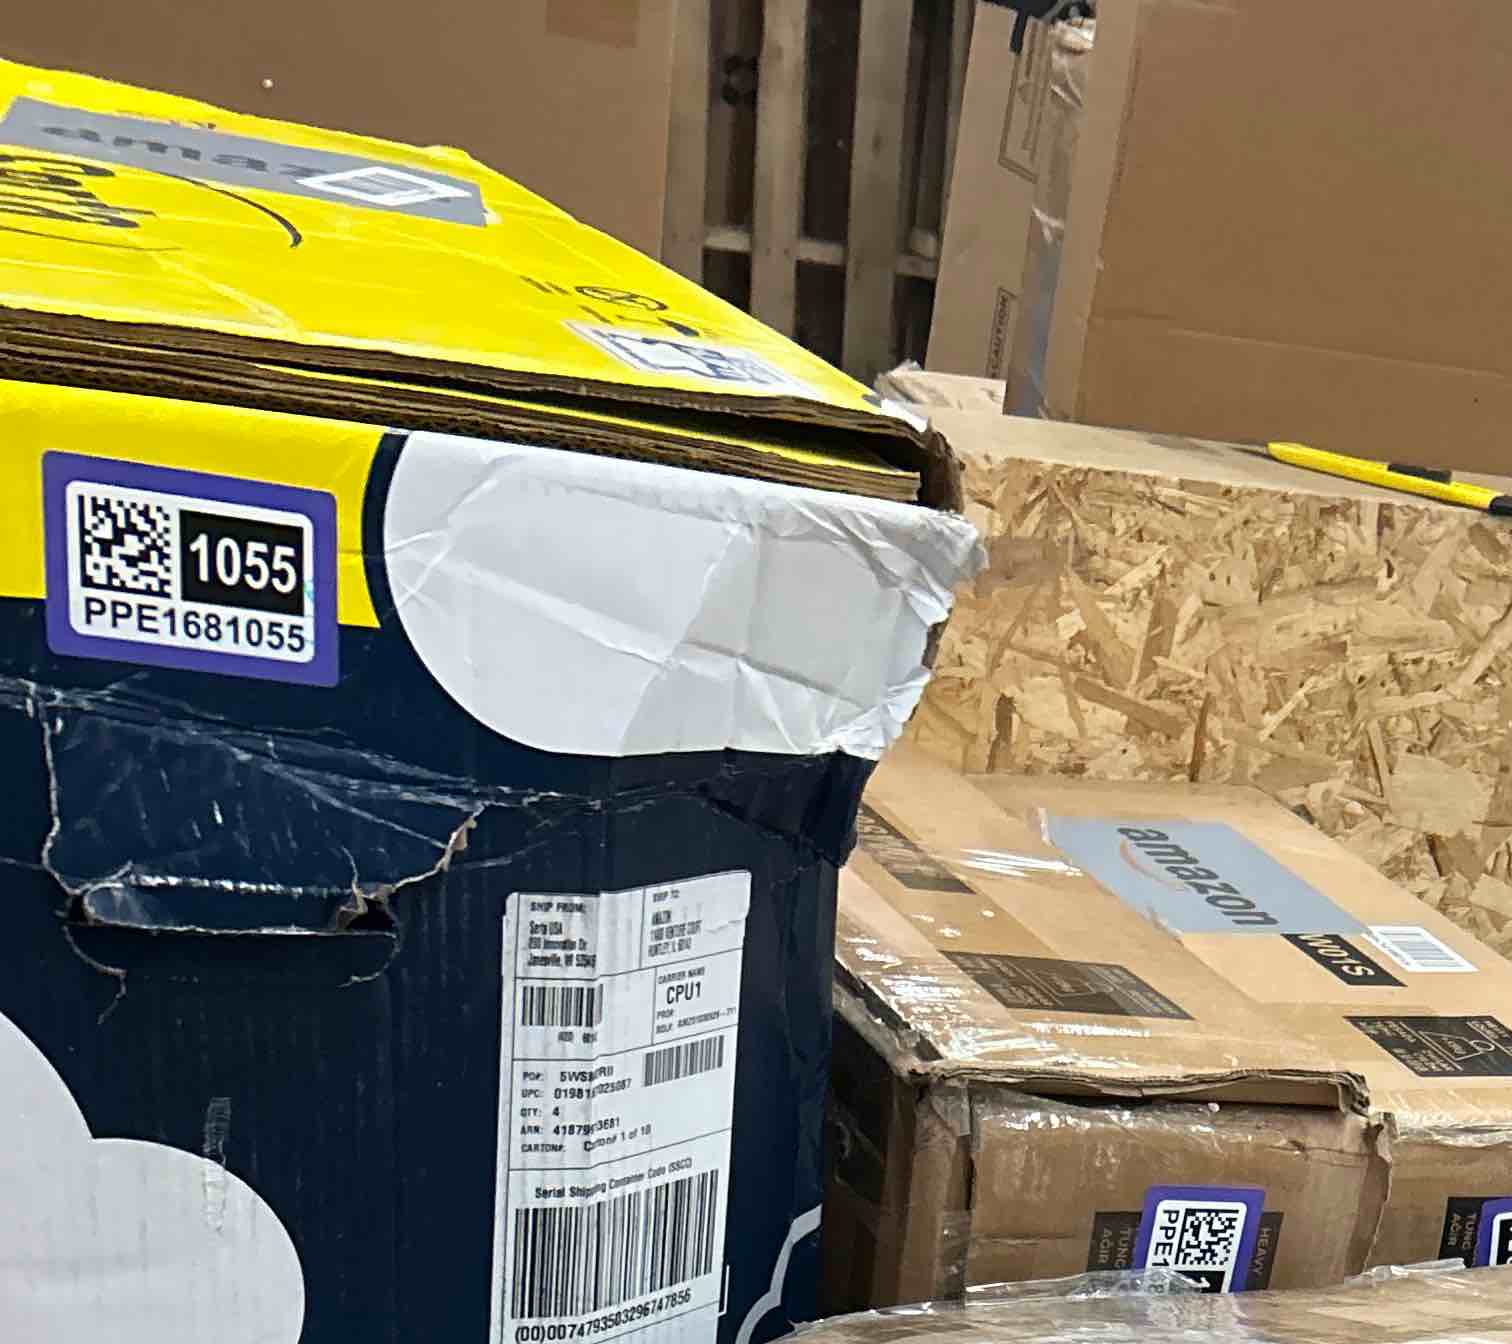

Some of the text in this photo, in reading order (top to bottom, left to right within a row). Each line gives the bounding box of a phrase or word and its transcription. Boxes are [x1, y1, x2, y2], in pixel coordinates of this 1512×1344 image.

[189, 531, 297, 593] 1055
[84, 596, 306, 653] PPE1681055
[1116, 826, 1281, 927] amazon
[666, 981, 702, 1005] CPU1
[552, 1106, 561, 1117] 4
[535, 1186, 566, 1199] Serial
[569, 1177, 607, 1199] Shipping
[608, 1171, 645, 1190] Container
[1113, 1227, 1131, 1268] TUNG
[1150, 1209, 1181, 1270] PPE1
[1253, 1226, 1272, 1275] HEAVY
